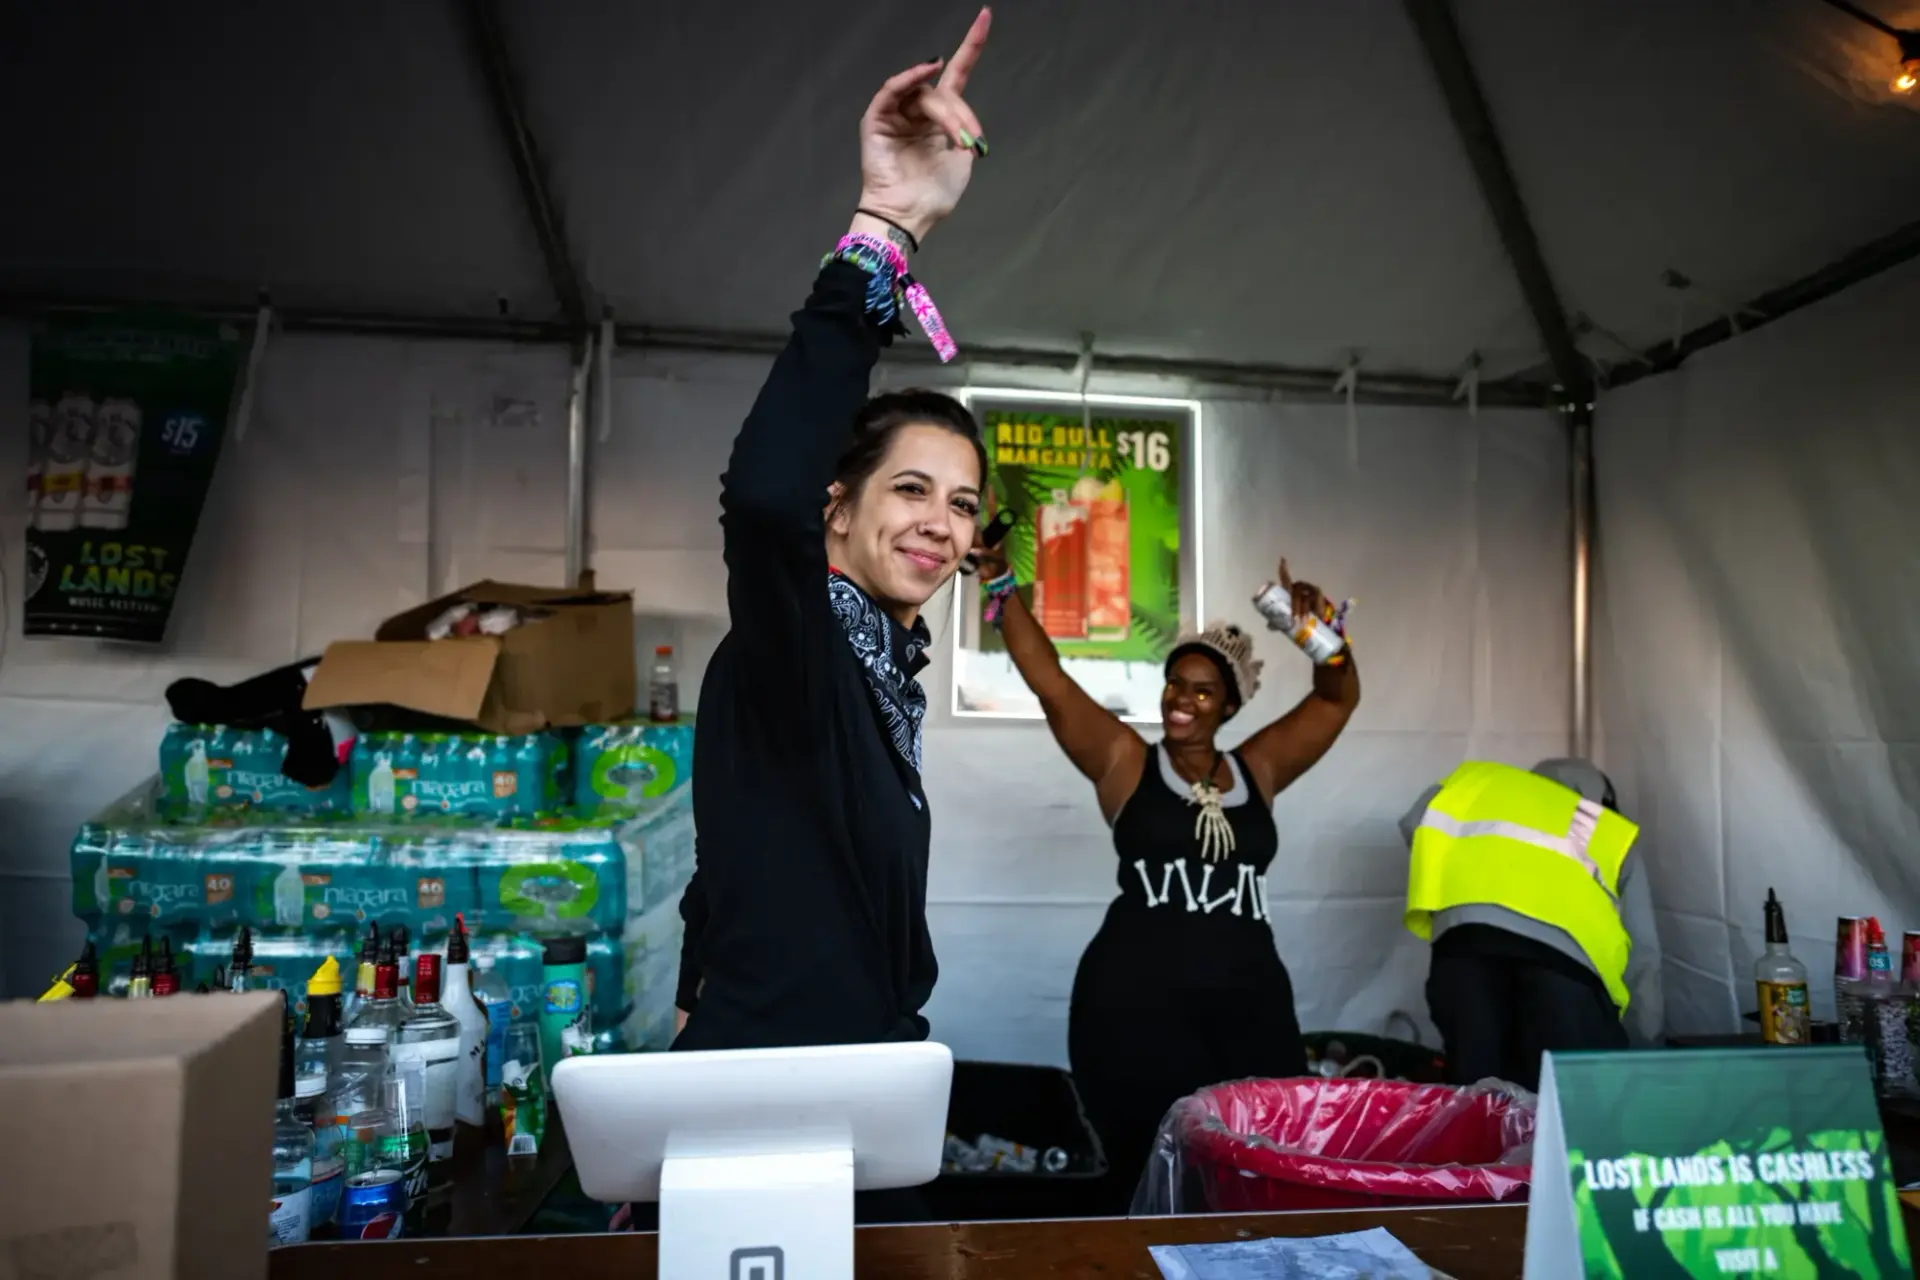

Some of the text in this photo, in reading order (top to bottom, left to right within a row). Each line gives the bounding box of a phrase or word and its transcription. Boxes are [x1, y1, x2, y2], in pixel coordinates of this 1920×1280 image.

[160, 415, 205, 449] $15
[996, 423, 1112, 449] RED BULL
[1116, 430, 1171, 473] $16
[80, 541, 169, 572] LOST
[59, 563, 177, 599] LANDS
[411, 780, 487, 798] niagara
[207, 877, 231, 890] 40
[324, 887, 409, 907] niagara
[1584, 1150, 1875, 1190] LOST LANDS IS CASHLESS
[1633, 1201, 1844, 1232] IF CASH IS ALL YOU HAVE
[1714, 1248, 1779, 1273] VISIT A
